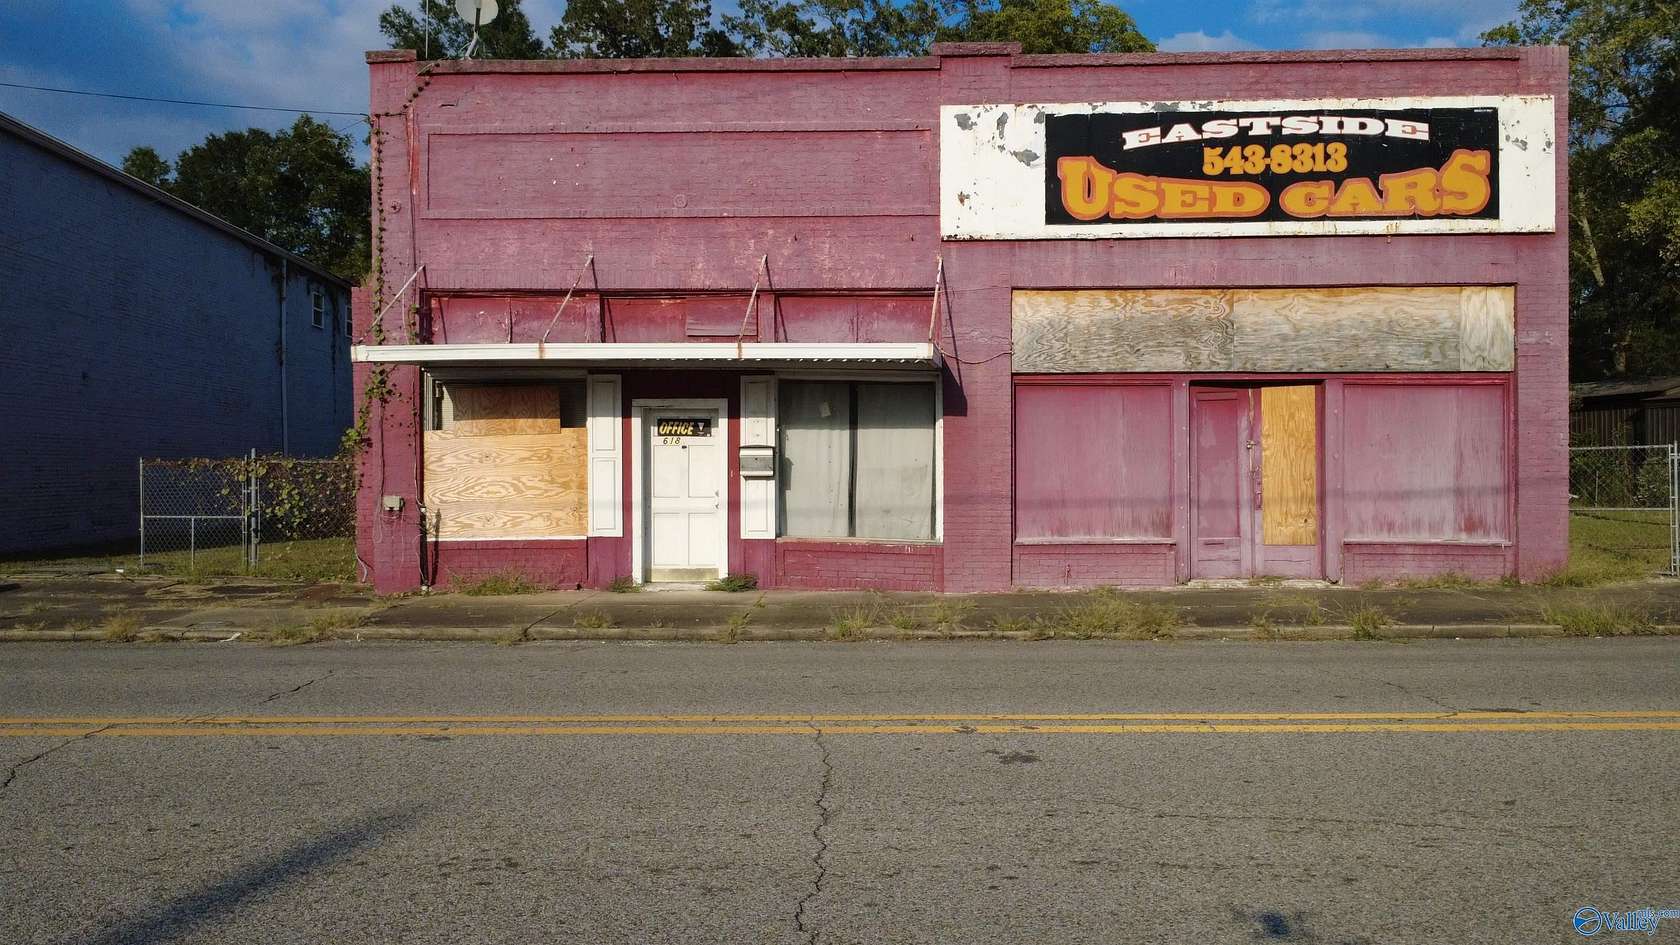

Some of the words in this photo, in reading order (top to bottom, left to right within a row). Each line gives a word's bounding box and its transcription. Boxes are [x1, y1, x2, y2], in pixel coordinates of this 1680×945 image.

[1122, 116, 1430, 150] EASTSIDE
[1203, 143, 1347, 175] 543-8313
[1058, 156, 1270, 219] USED
[1280, 150, 1491, 218] CARS
[660, 422, 694, 435] OFFICE
